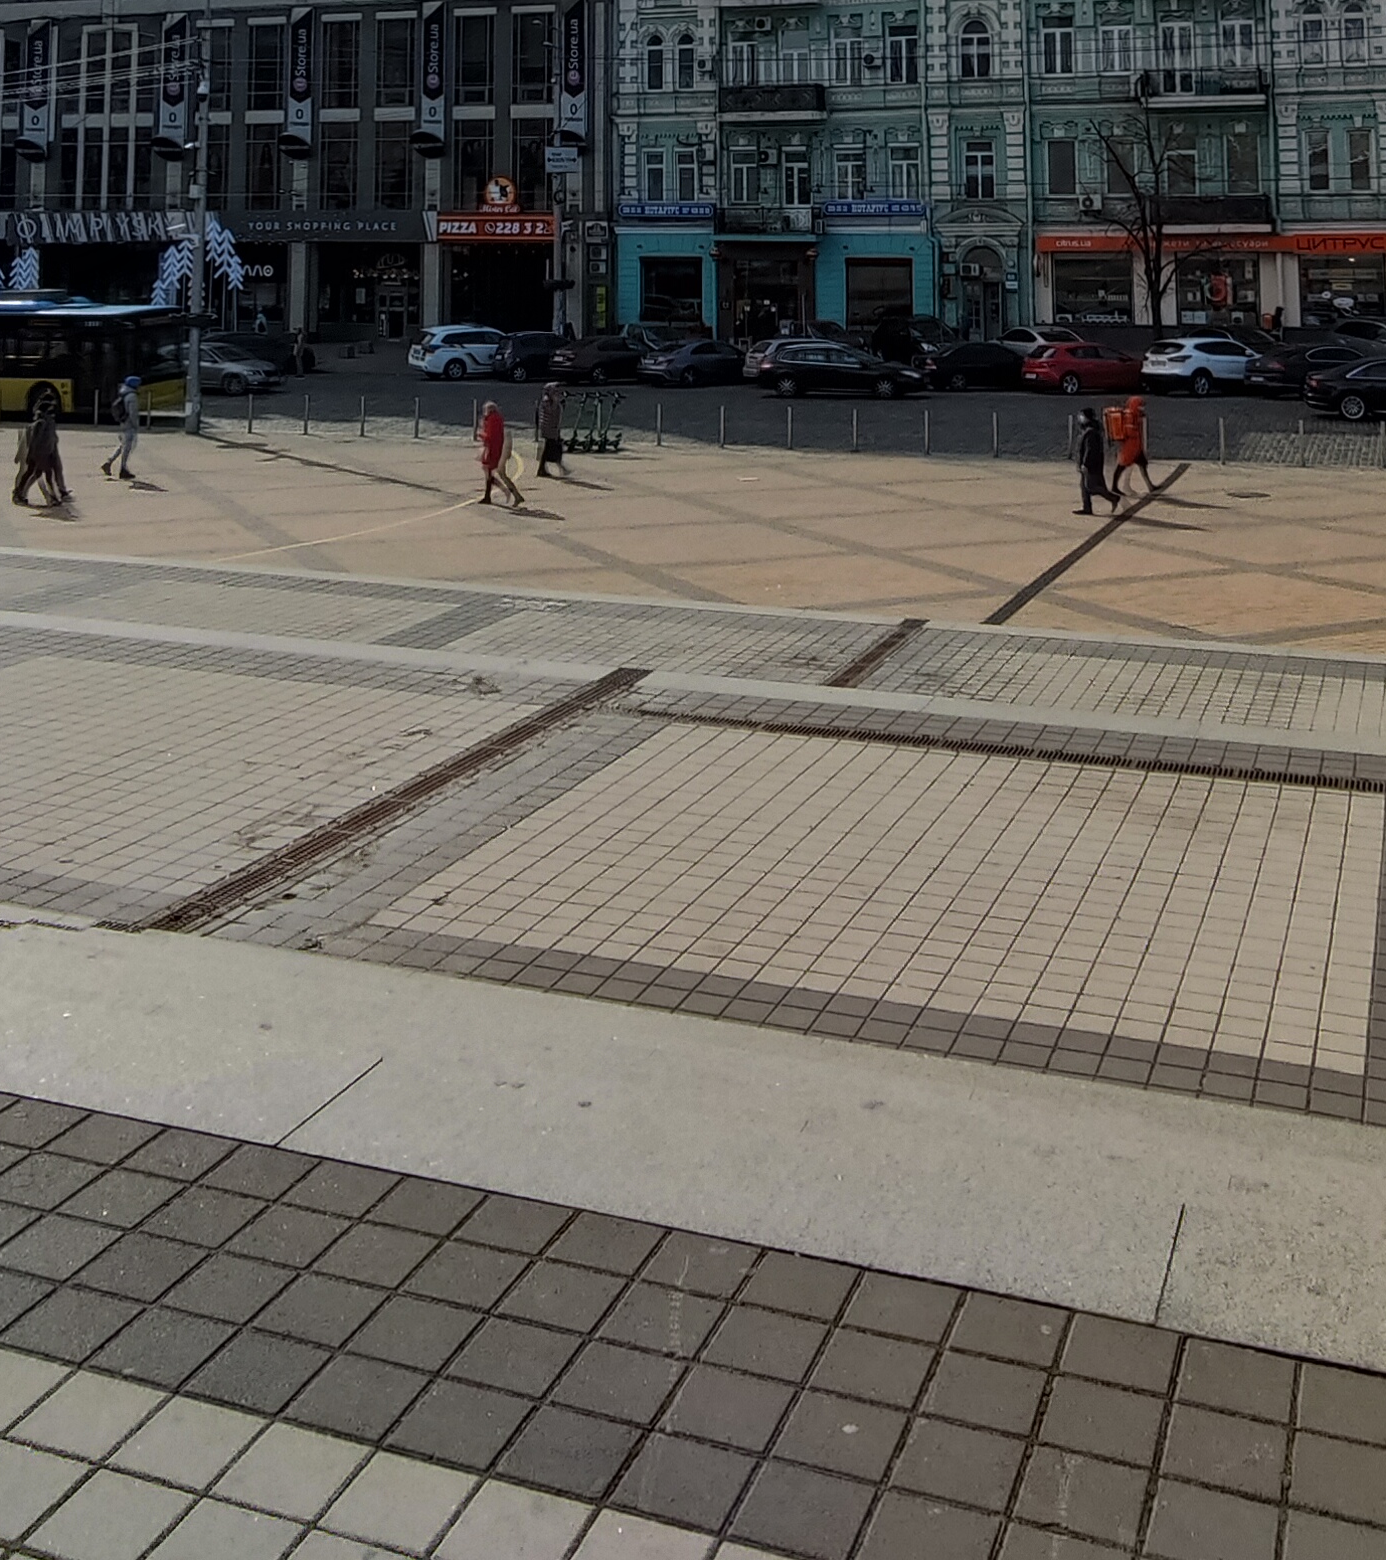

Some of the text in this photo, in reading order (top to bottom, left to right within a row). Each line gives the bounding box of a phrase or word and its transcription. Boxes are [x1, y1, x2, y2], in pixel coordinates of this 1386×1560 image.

[566, 19, 581, 86] eStore.ua
[248, 221, 397, 231] YOUR SHOPPING PLACE
[438, 221, 477, 234] PIZZA
[495, 221, 520, 234] 228
[523, 221, 532, 234] 3
[1296, 236, 1385, 251] ЦИТРУС
